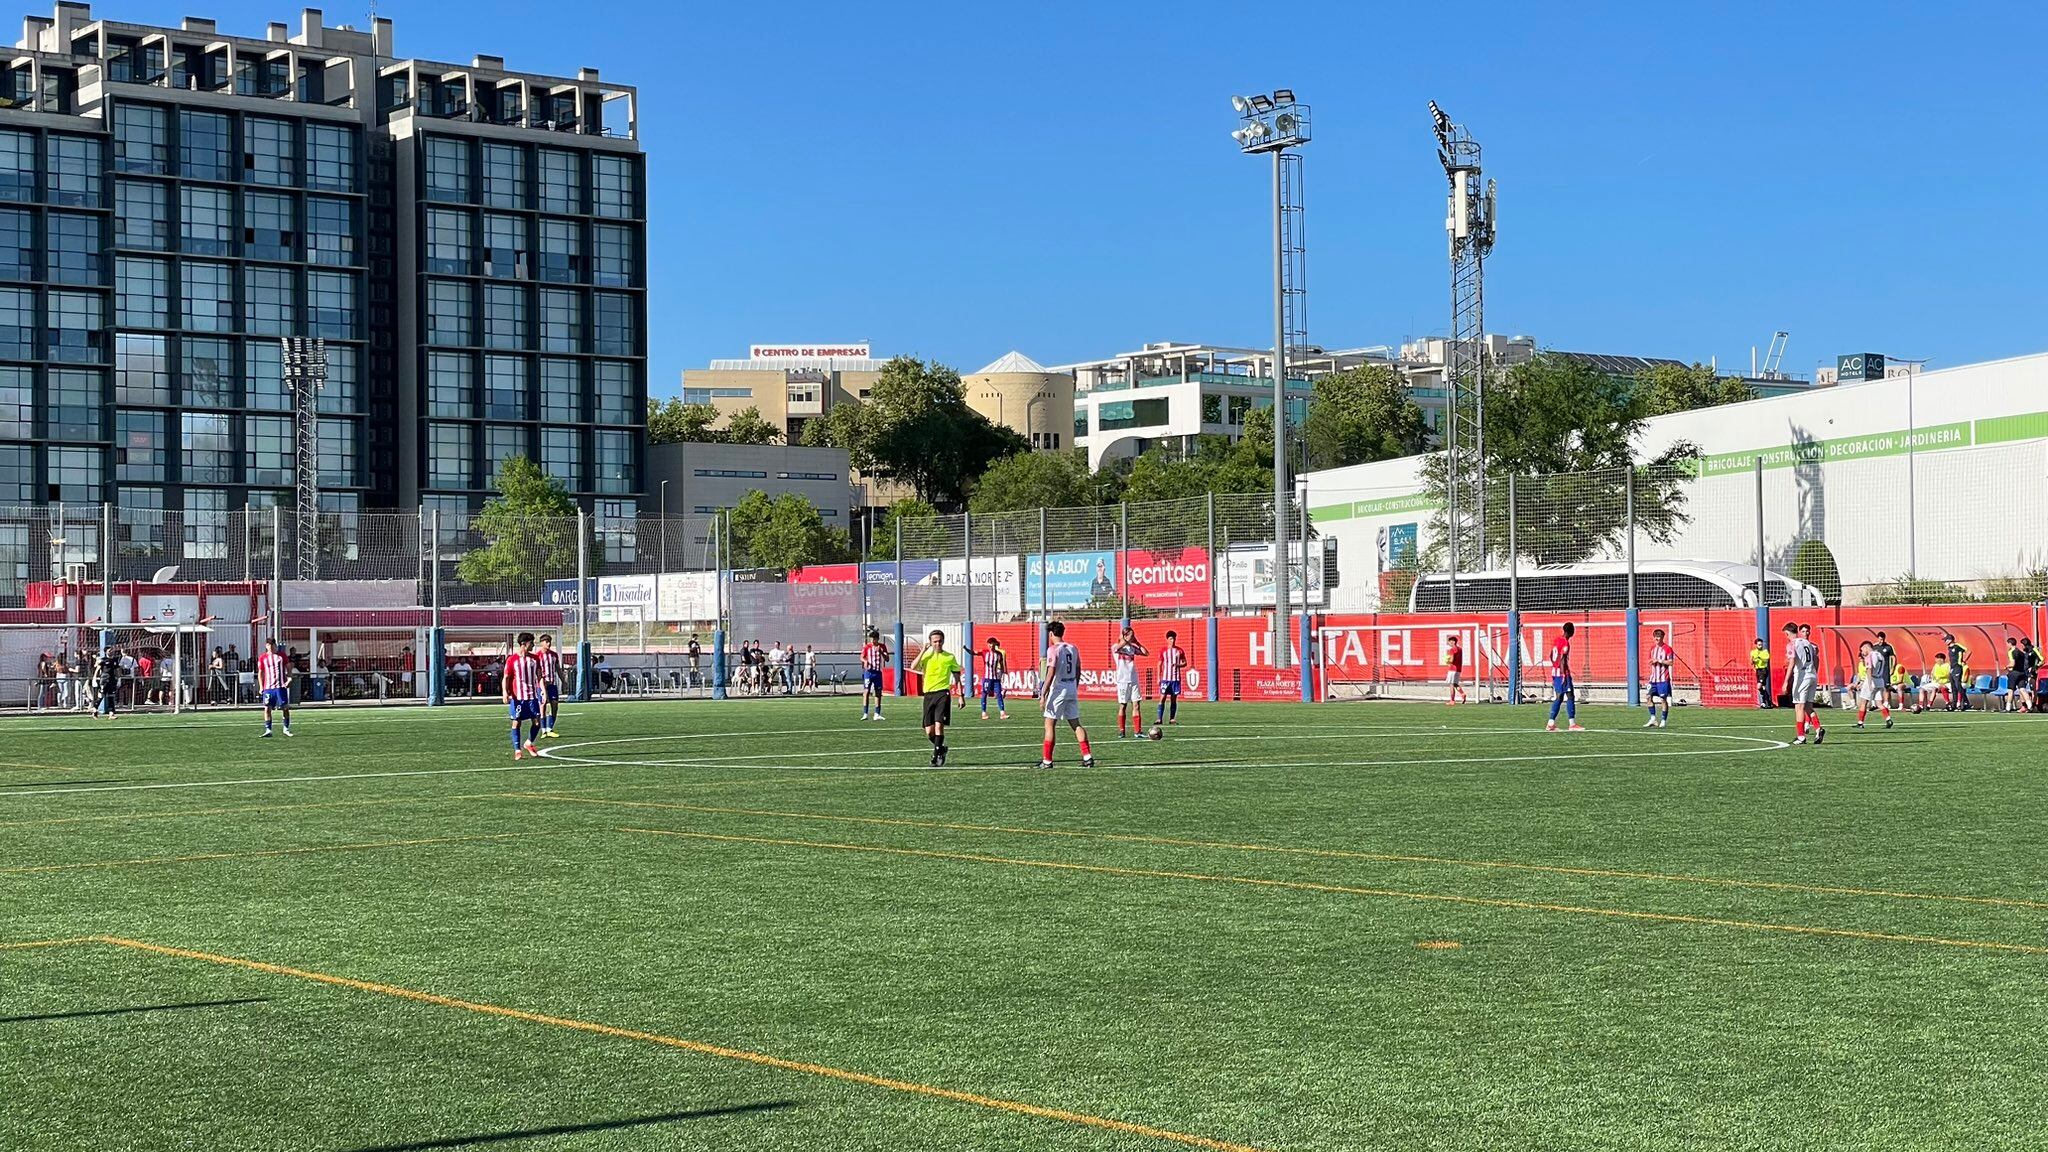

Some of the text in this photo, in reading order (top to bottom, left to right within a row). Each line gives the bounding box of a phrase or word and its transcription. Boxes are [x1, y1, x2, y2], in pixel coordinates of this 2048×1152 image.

[762, 348, 867, 357] CENTRO DE EMPRESAS
[1841, 357, 1862, 371] AC
[1867, 357, 1883, 371] AC
[1708, 455, 1751, 471] BRICOLAJE
[1829, 438, 1894, 457] DECORACION
[1899, 428, 1961, 448] JARDINERIA
[1056, 558, 1090, 575] ABLOY
[1127, 559, 1206, 585] tecnitasa
[946, 571, 972, 585] PLAZA
[974, 570, 1002, 584] NORTE
[1381, 629, 1424, 666] EL
